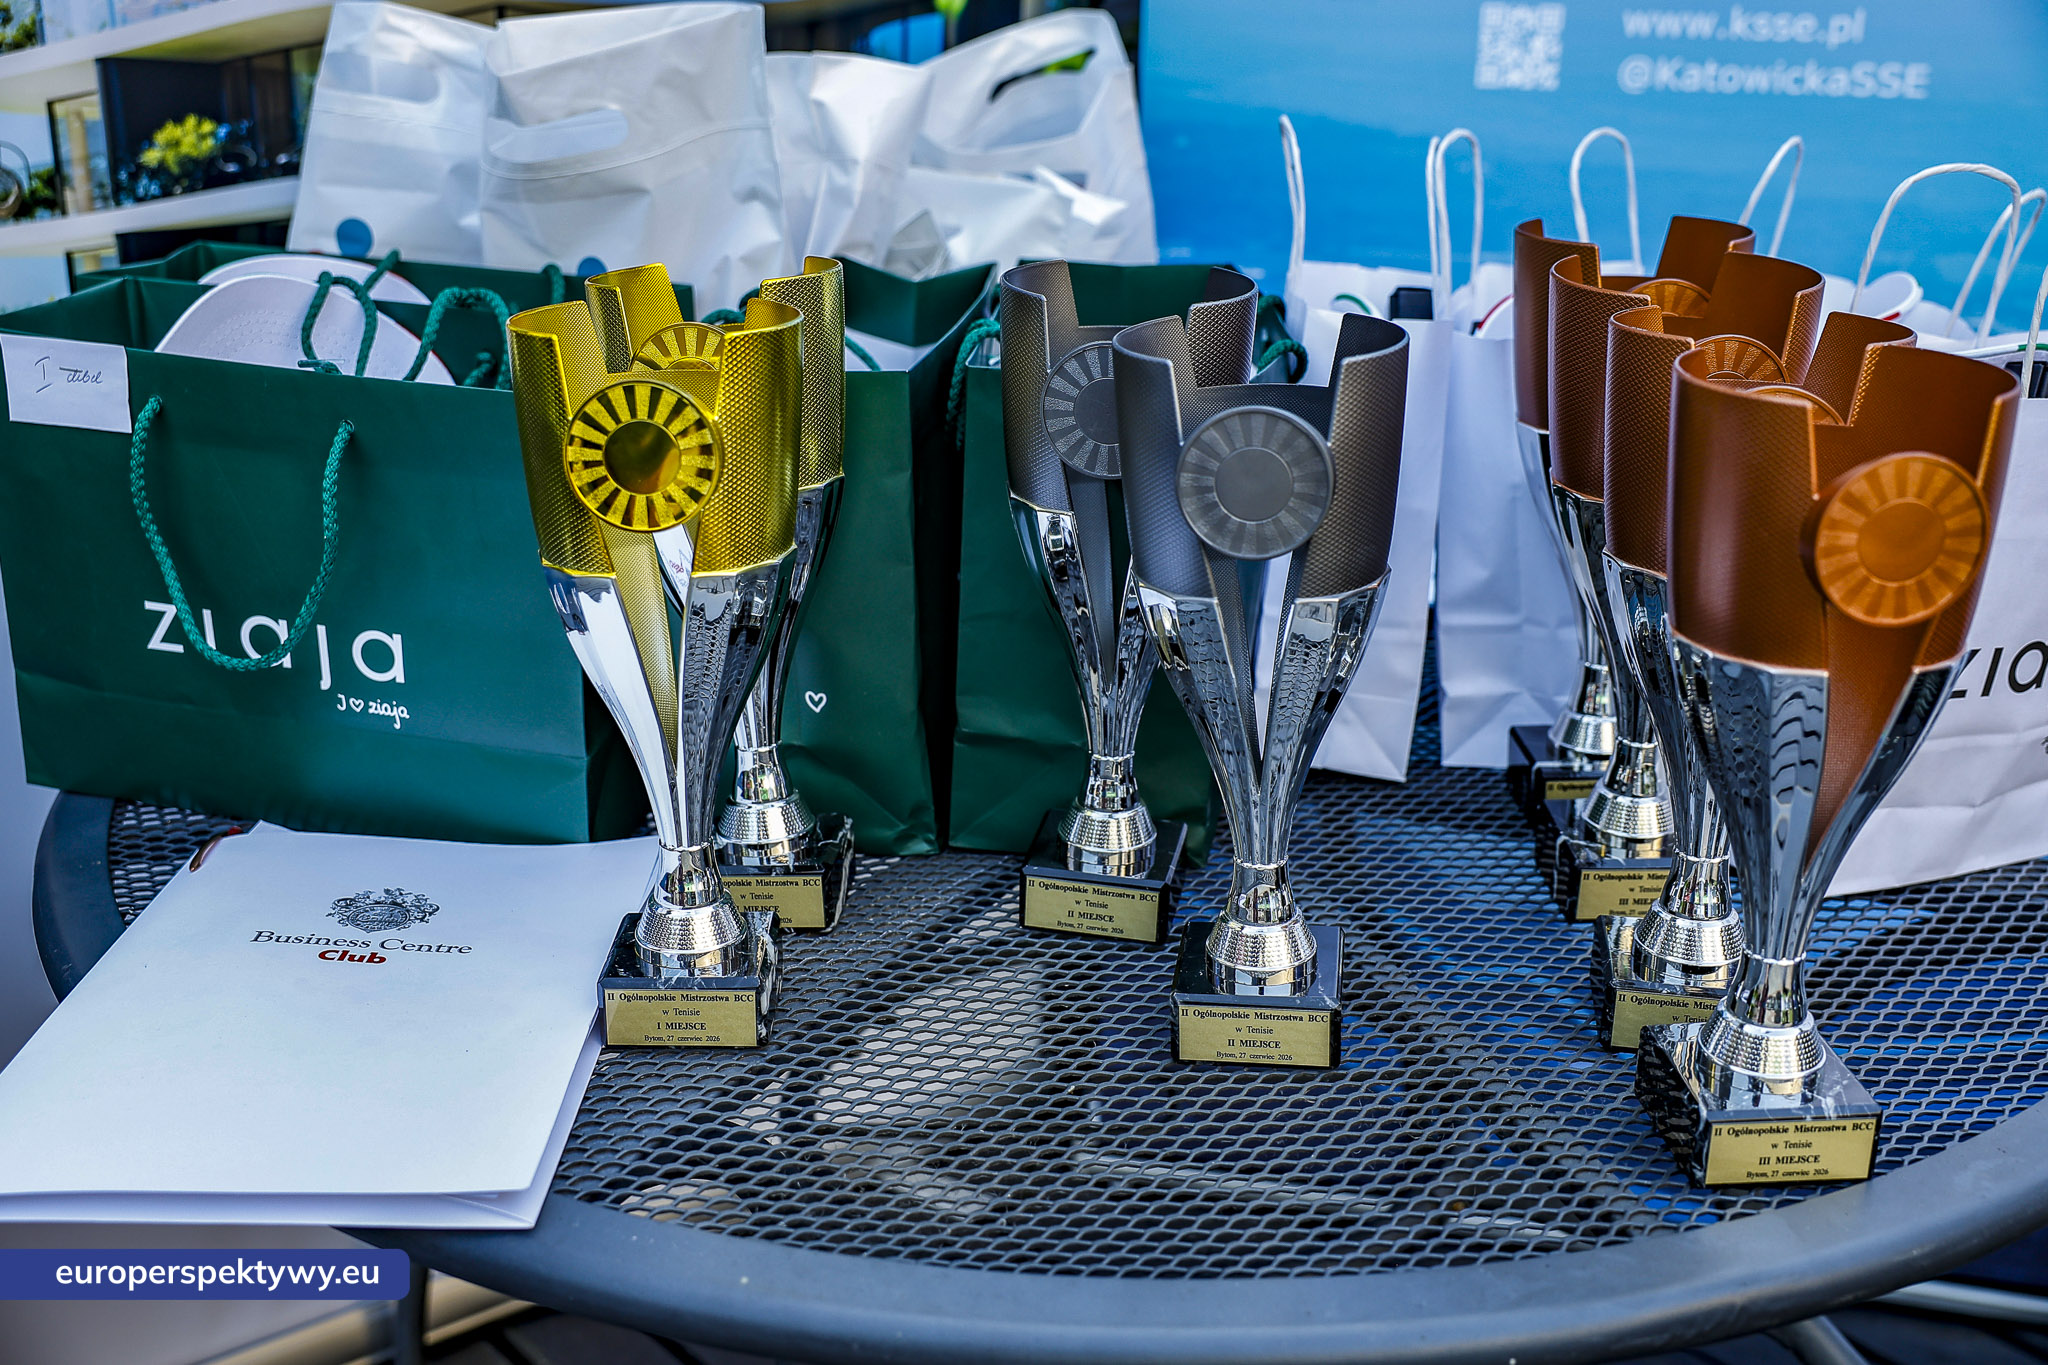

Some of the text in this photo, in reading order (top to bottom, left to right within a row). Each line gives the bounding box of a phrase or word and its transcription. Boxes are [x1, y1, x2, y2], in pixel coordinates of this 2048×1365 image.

[1622, 3, 1867, 50] www.ksse.pl
[1617, 53, 1932, 99] @KatowickaSSE
[144, 600, 405, 690] ziaja
[368, 699, 410, 729] ziaja
[723, 879, 820, 888] opolskie Mistrzostwa BCC
[749, 892, 774, 900] Tenisie
[1028, 879, 1157, 903] II Ogólnopolskie Mistrzostwa BCC
[1084, 900, 1108, 910] Tenisie
[1067, 910, 1115, 923] II MIEJSCE
[250, 930, 473, 954] Business Centre
[318, 949, 387, 964] Club
[607, 992, 754, 1004] II Ogólnopolskie Mistrzostwa BCC
[1618, 994, 1717, 1011] II Ogólnopolskie Mistr
[673, 1007, 700, 1016] Tenisie
[1181, 1009, 1328, 1023] II Ogólnopolskie Mistrzostwa BCC
[1684, 1015, 1708, 1023] Tenisi
[656, 1021, 707, 1030] I MIEJSCE
[1246, 1025, 1273, 1034] Tenisie
[644, 1035, 665, 1043] Bytom,
[1227, 1039, 1281, 1049] II MIEJSCE
[1216, 1051, 1238, 1059] Bytom,
[1714, 1122, 1874, 1137] II Ogólnopolskie Mistrzostwa BCC
[1783, 1140, 1813, 1149] Tenisie
[1758, 1155, 1821, 1165] III MIEJSCE
